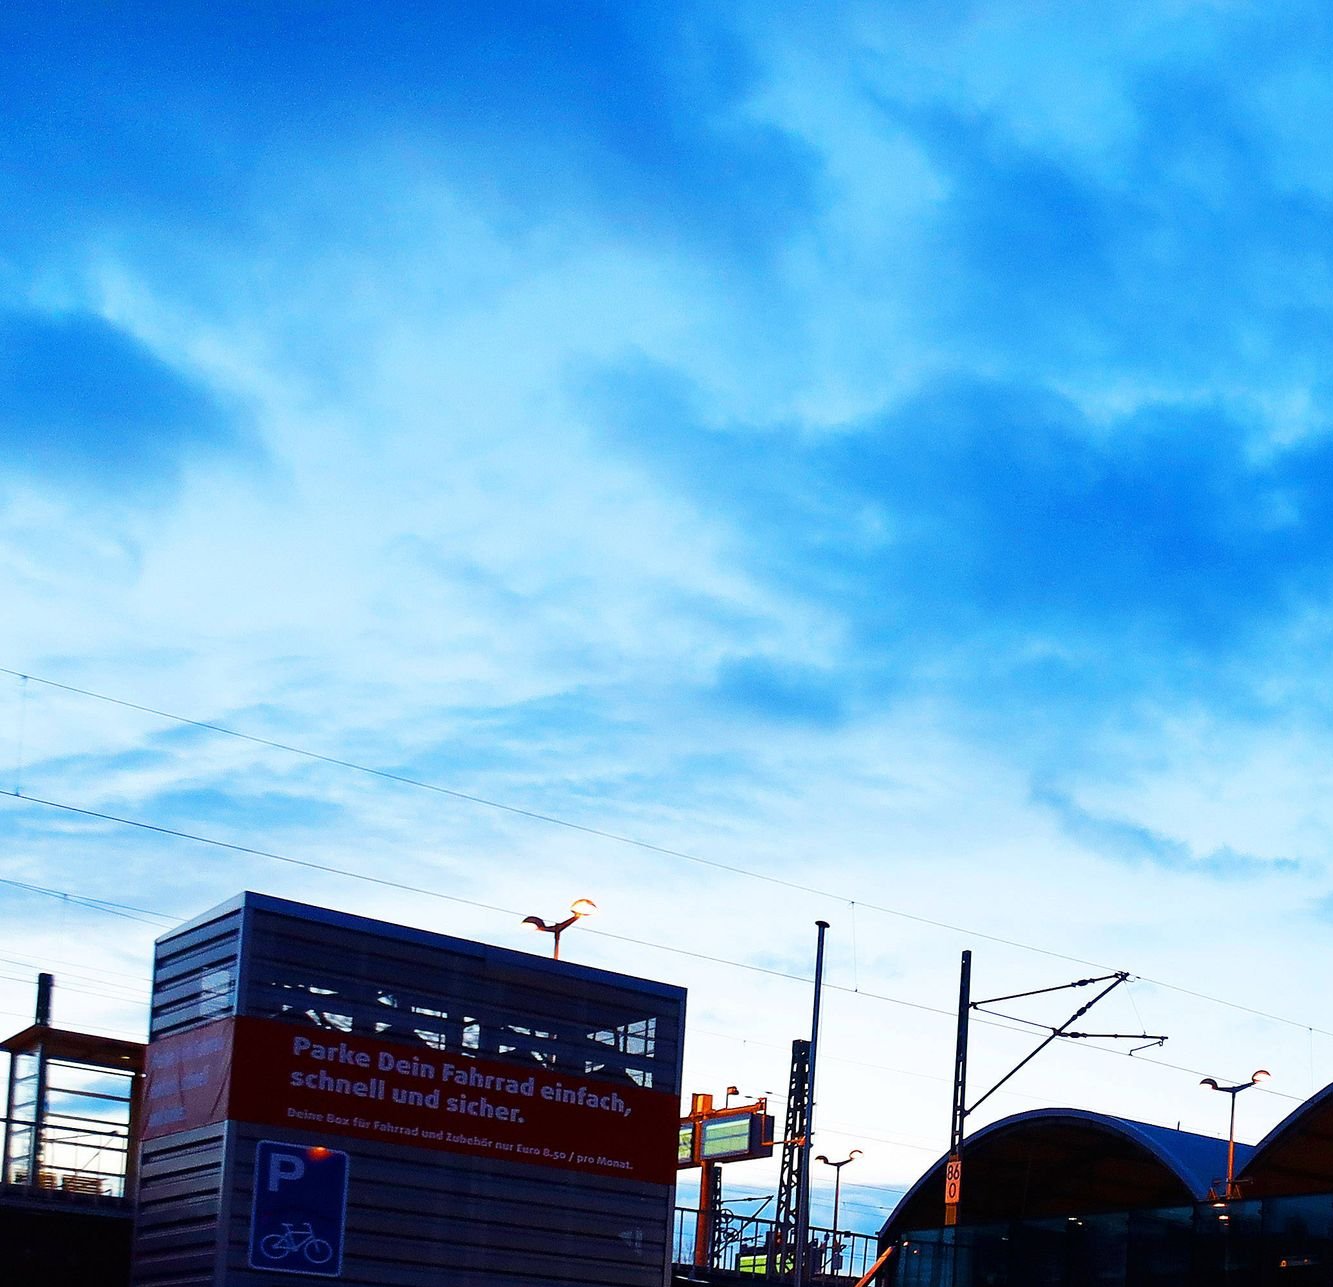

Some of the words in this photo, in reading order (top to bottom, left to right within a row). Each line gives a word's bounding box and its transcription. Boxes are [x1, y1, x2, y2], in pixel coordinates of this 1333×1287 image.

[290, 1069, 385, 1100] schnell
[392, 1088, 440, 1109] und
[446, 1093, 526, 1124] sicher.
[293, 1036, 371, 1068] Parke
[378, 1051, 435, 1080] Dein
[442, 1063, 535, 1097] Fahrrad
[540, 1082, 632, 1117] einfach,
[287, 1107, 324, 1122] Deine
[326, 1113, 350, 1126] Box
[352, 1117, 371, 1129] für
[374, 1121, 418, 1137] Fahrrad
[421, 1129, 443, 1141] und
[446, 1131, 493, 1149] Zubehör
[495, 1141, 513, 1152] nur
[517, 1144, 541, 1156] Euro
[576, 1154, 594, 1165] pro
[597, 1156, 633, 1170] Monat.
[269, 1153, 304, 1191] P
[947, 1164, 960, 1180] 86
[949, 1182, 956, 1198] 0
